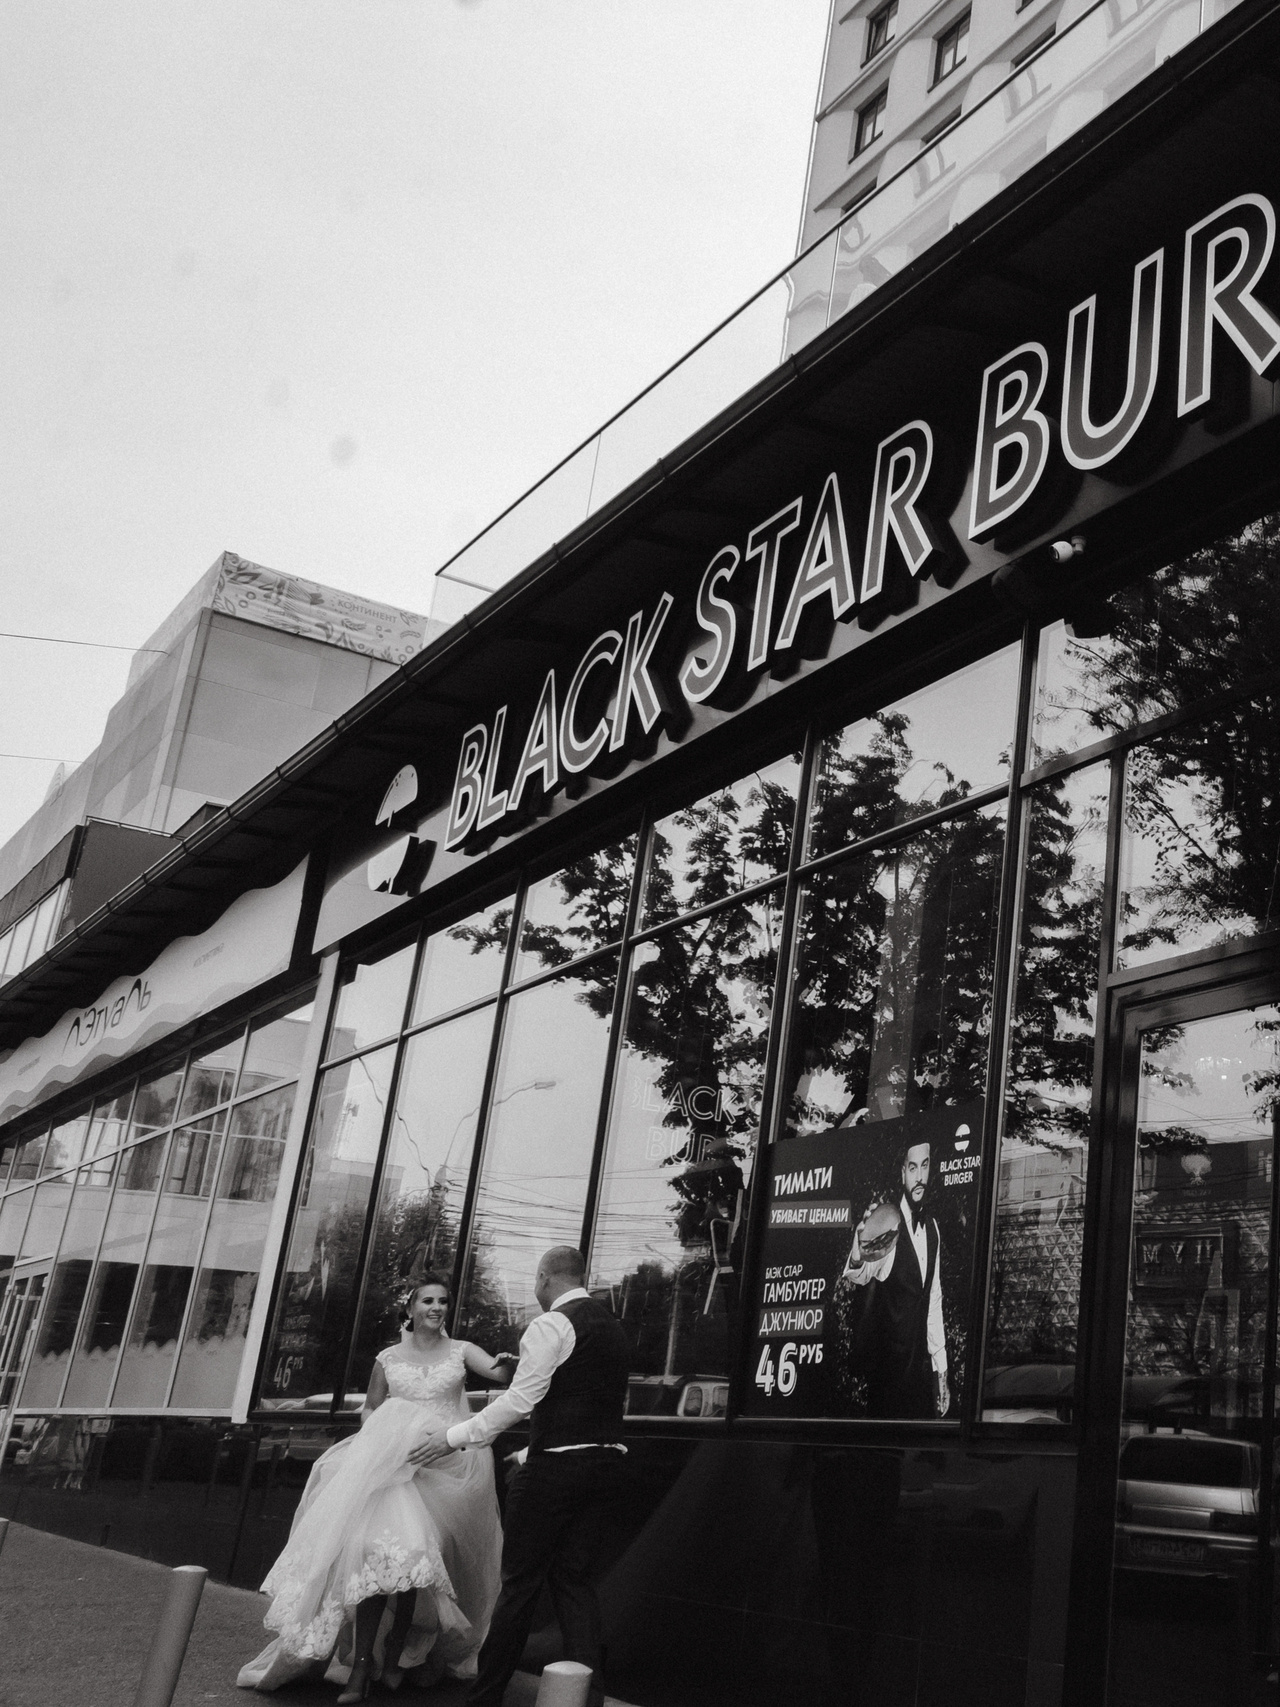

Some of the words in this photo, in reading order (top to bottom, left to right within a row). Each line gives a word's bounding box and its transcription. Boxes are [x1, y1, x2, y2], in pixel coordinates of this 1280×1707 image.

[338, 600, 397, 623] КОНТИНЕНТ
[445, 591, 674, 853] BLACK
[680, 419, 934, 703] STAR
[940, 1159, 962, 1173] BLACK
[963, 1155, 981, 1169] STAR
[774, 1166, 833, 1197] ТИМАТИ
[944, 1171, 973, 1186] BURGER
[771, 1208, 808, 1224] УБИВАЕТ
[809, 1207, 849, 1225] ЦЕНАМИ
[784, 1264, 803, 1278] СТАР
[763, 1278, 826, 1303] ГАМБУРГЕР
[759, 1309, 823, 1336] ДЖУНИОР
[755, 1342, 798, 1397] 46
[799, 1344, 823, 1364] РУБ
